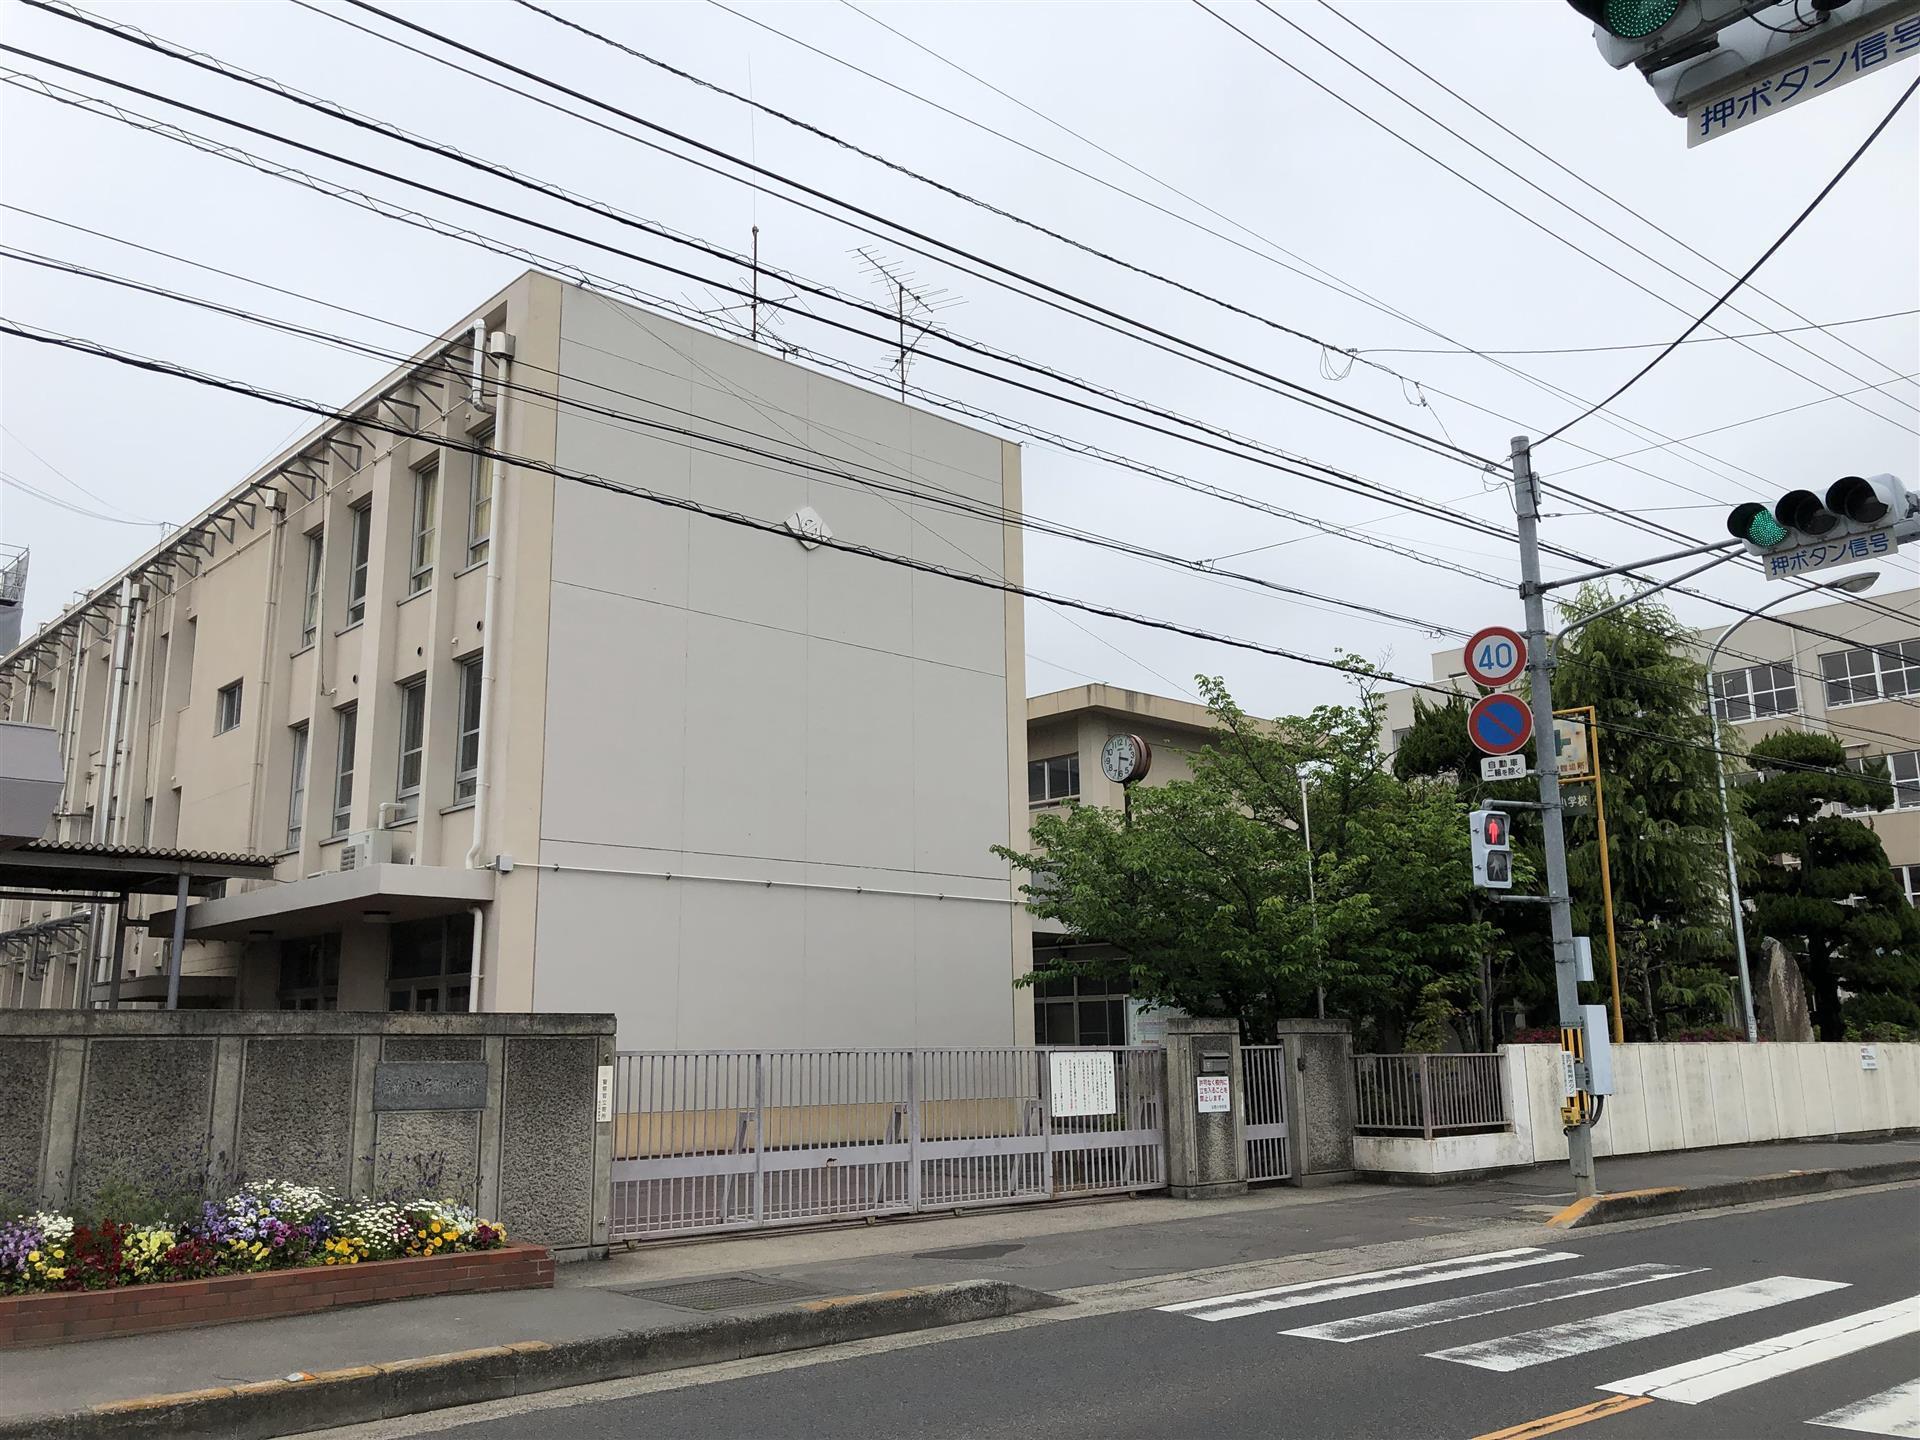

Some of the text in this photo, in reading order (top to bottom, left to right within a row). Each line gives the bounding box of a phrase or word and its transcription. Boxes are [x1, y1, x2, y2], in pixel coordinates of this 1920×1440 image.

[1700, 17, 1920, 136] 押ボタン信号
[1770, 532, 1889, 576] 押ボタン信号
[1478, 642, 1513, 670] 40
[1561, 795, 1588, 807] 小学校
